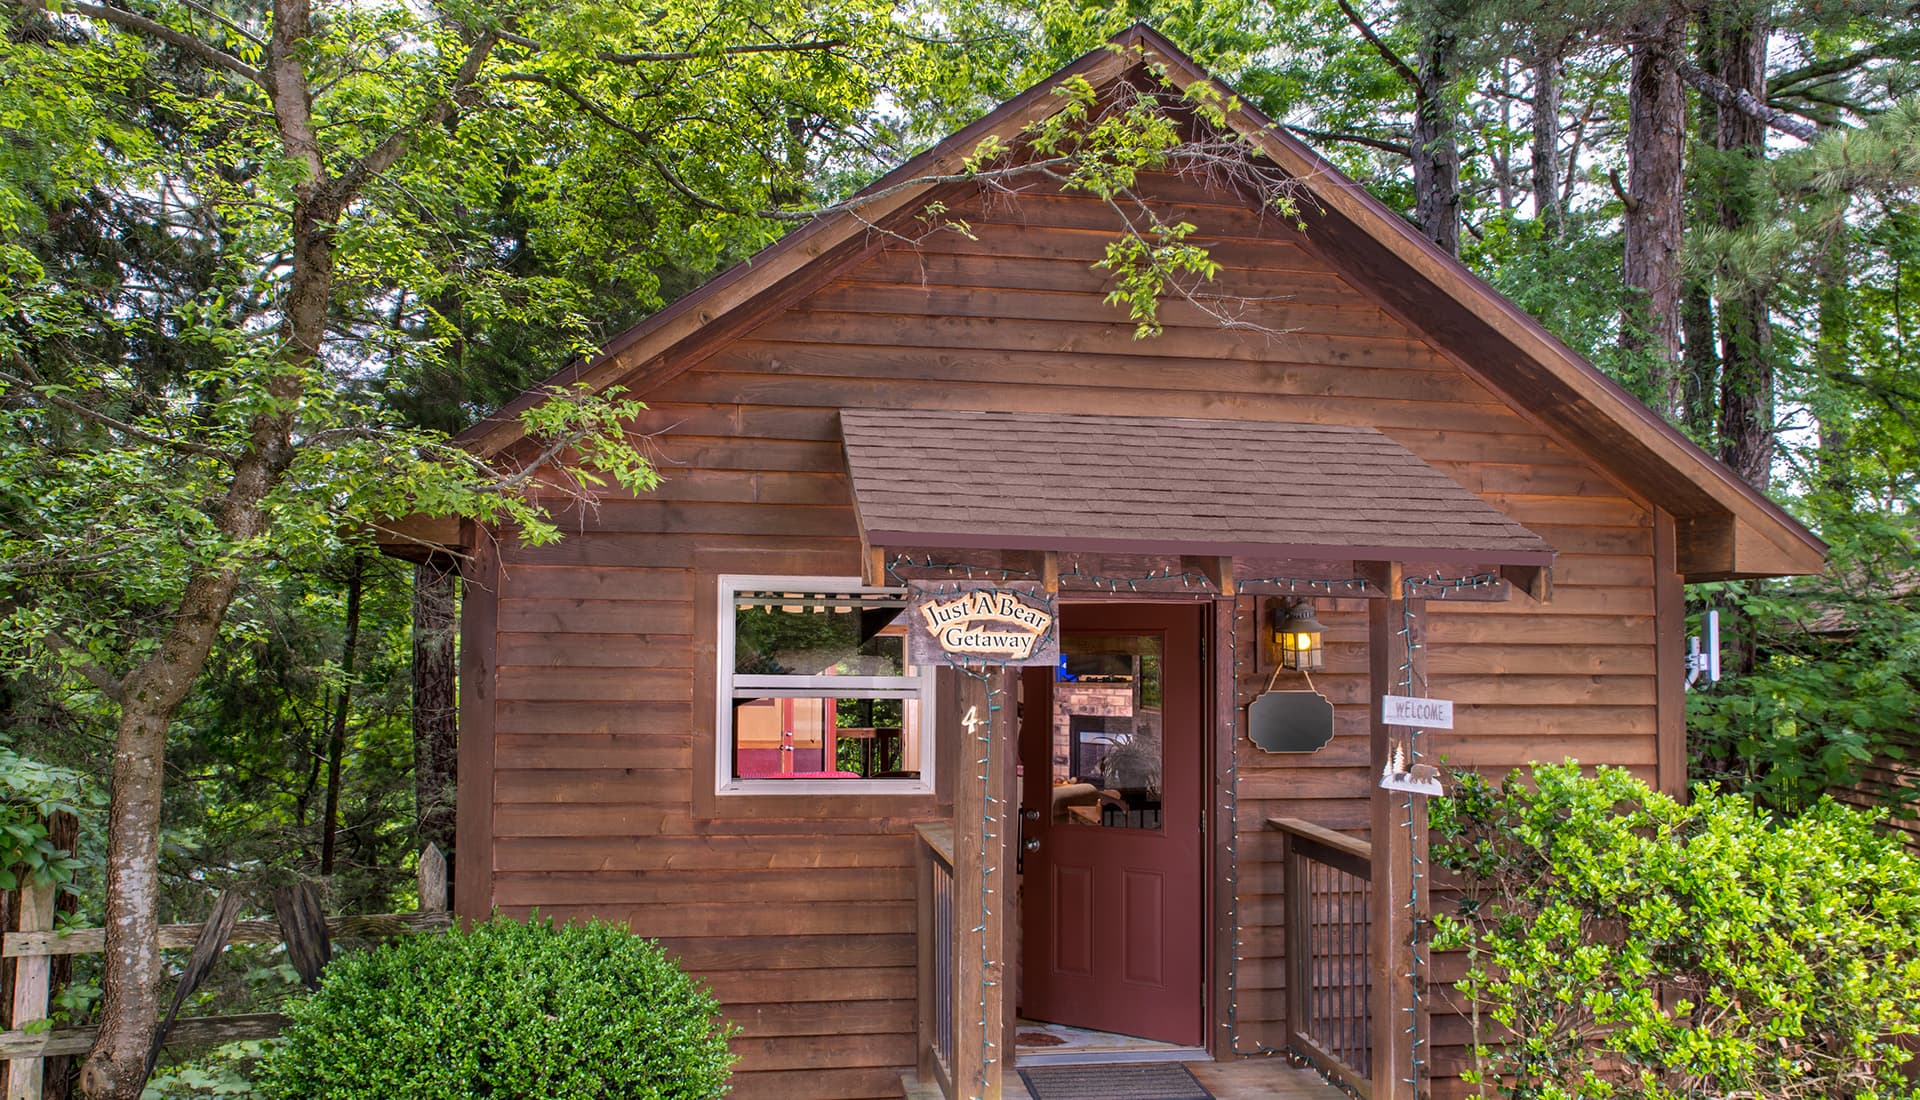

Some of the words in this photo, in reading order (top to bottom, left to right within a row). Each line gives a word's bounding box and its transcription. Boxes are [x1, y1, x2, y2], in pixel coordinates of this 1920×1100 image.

[926, 601, 969, 629] Just
[976, 596, 993, 615] A
[999, 598, 1047, 629] Bear
[946, 628, 1031, 653] Getaway
[961, 705, 977, 734] 4
[1396, 701, 1444, 721] WELCOME
